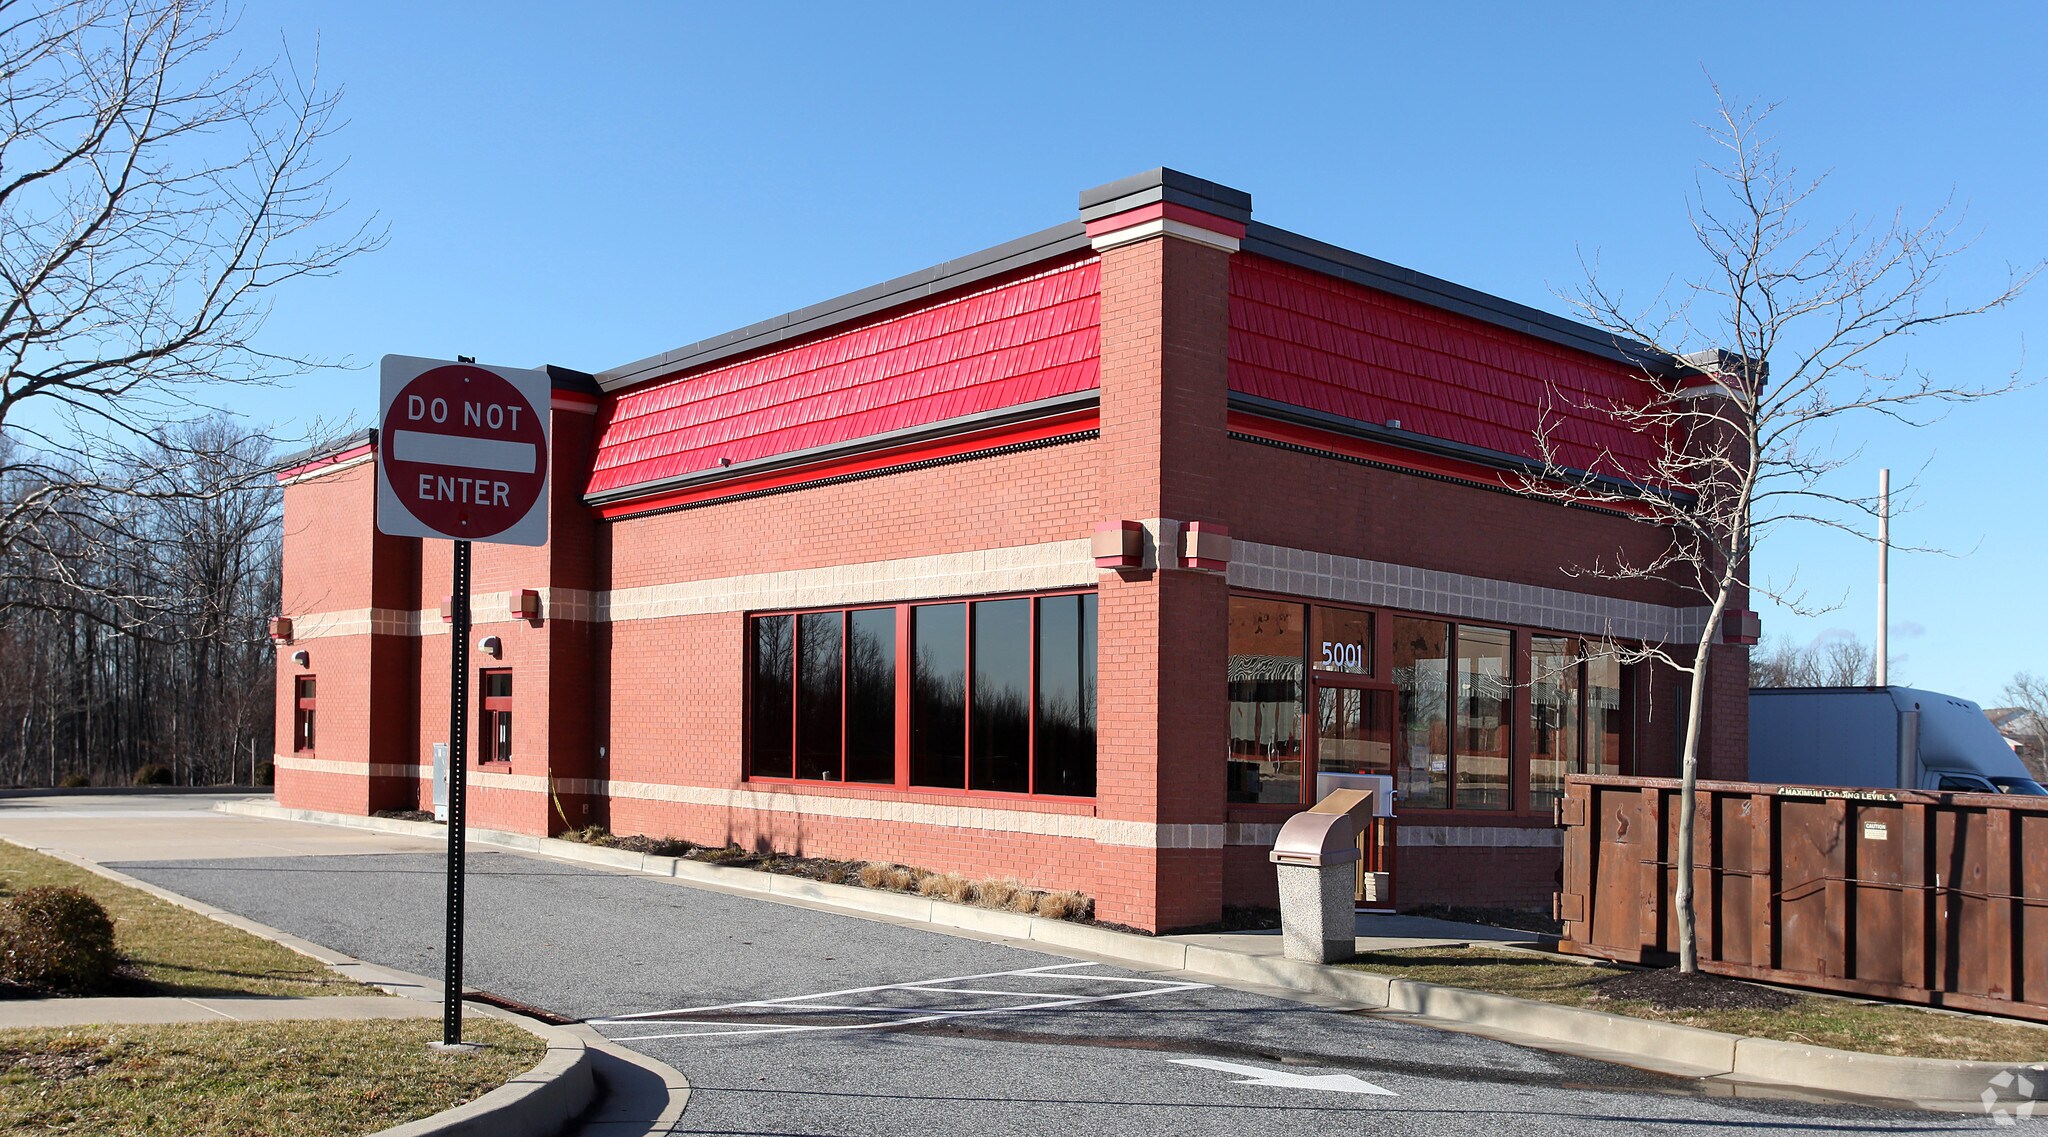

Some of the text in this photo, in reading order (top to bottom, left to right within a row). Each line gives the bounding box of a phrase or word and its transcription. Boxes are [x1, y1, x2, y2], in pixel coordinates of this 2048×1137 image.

[408, 394, 522, 431] DO NOT
[419, 473, 510, 507] ENTER
[1322, 641, 1362, 668] 5001
[1785, 787, 1888, 801] MAXIMUM LOADING LEVEL
